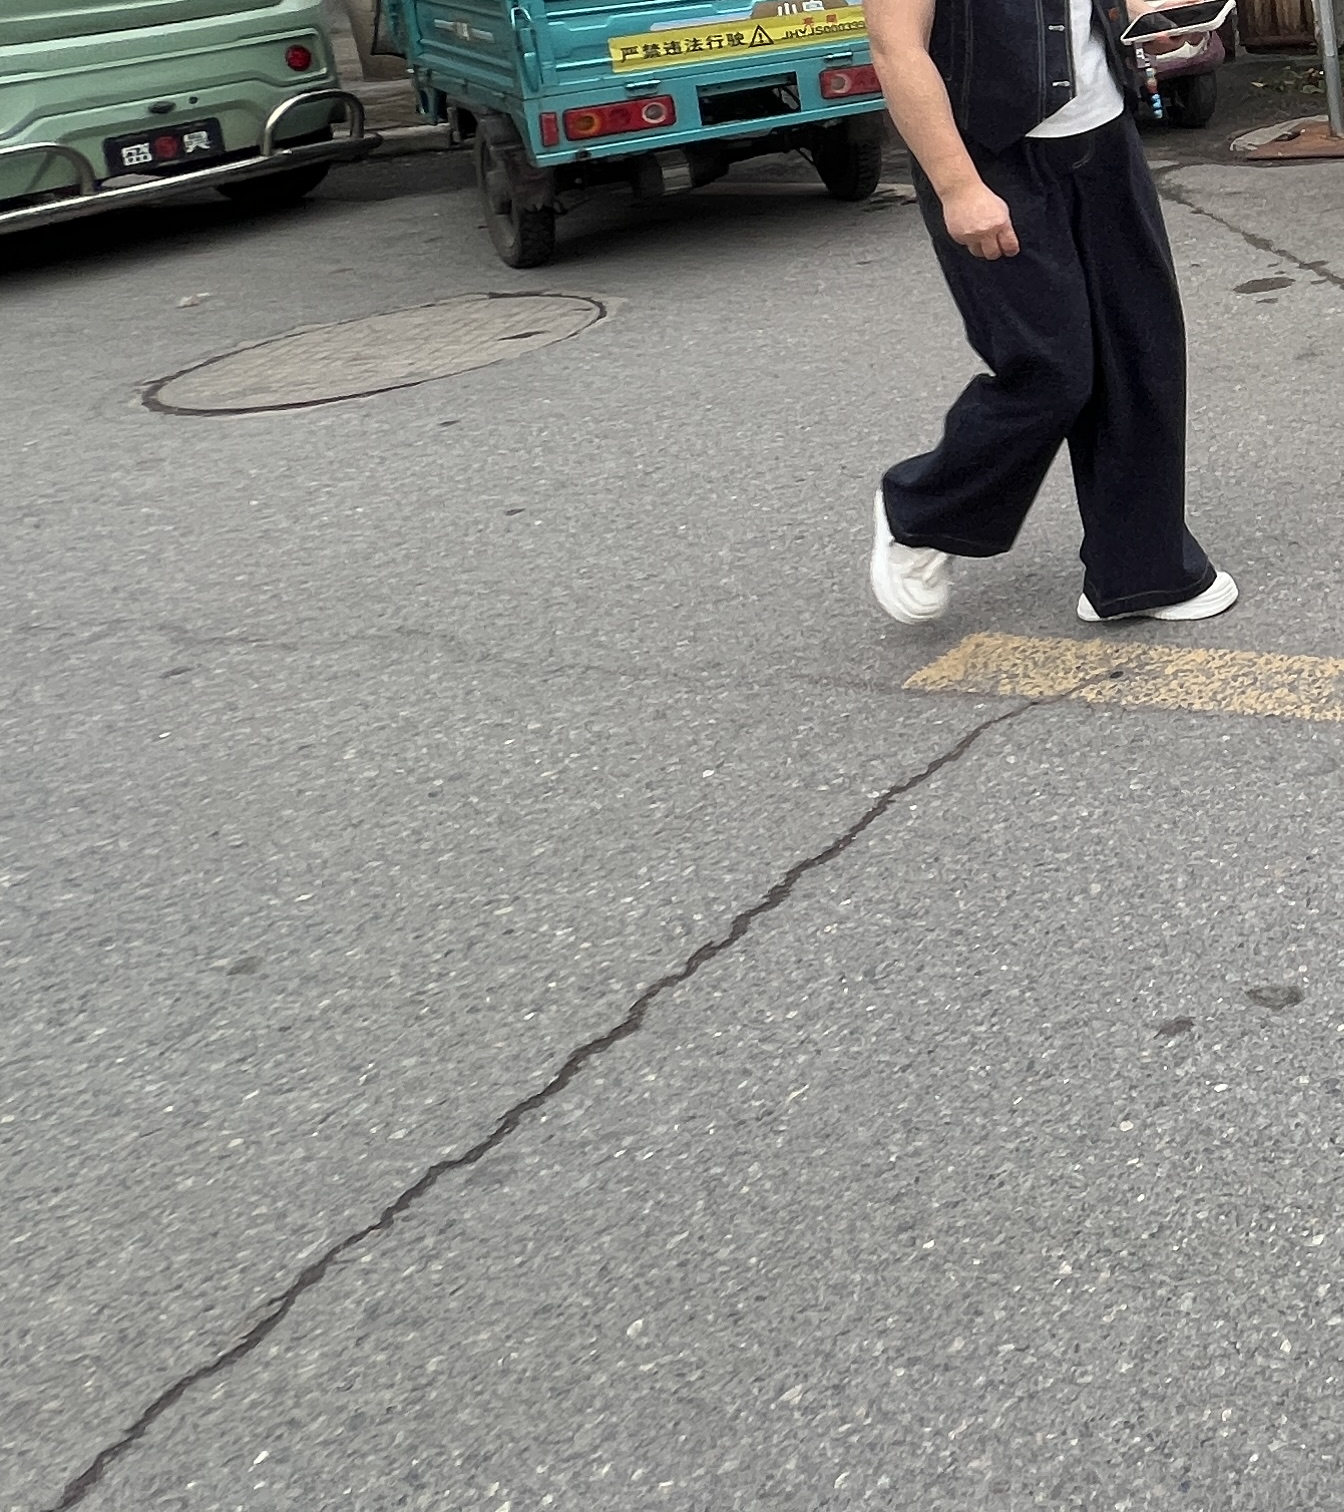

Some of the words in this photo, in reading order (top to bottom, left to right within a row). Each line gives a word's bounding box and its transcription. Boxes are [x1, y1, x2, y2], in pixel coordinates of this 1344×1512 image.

[619, 32, 746, 62] 严禁违法行驶
